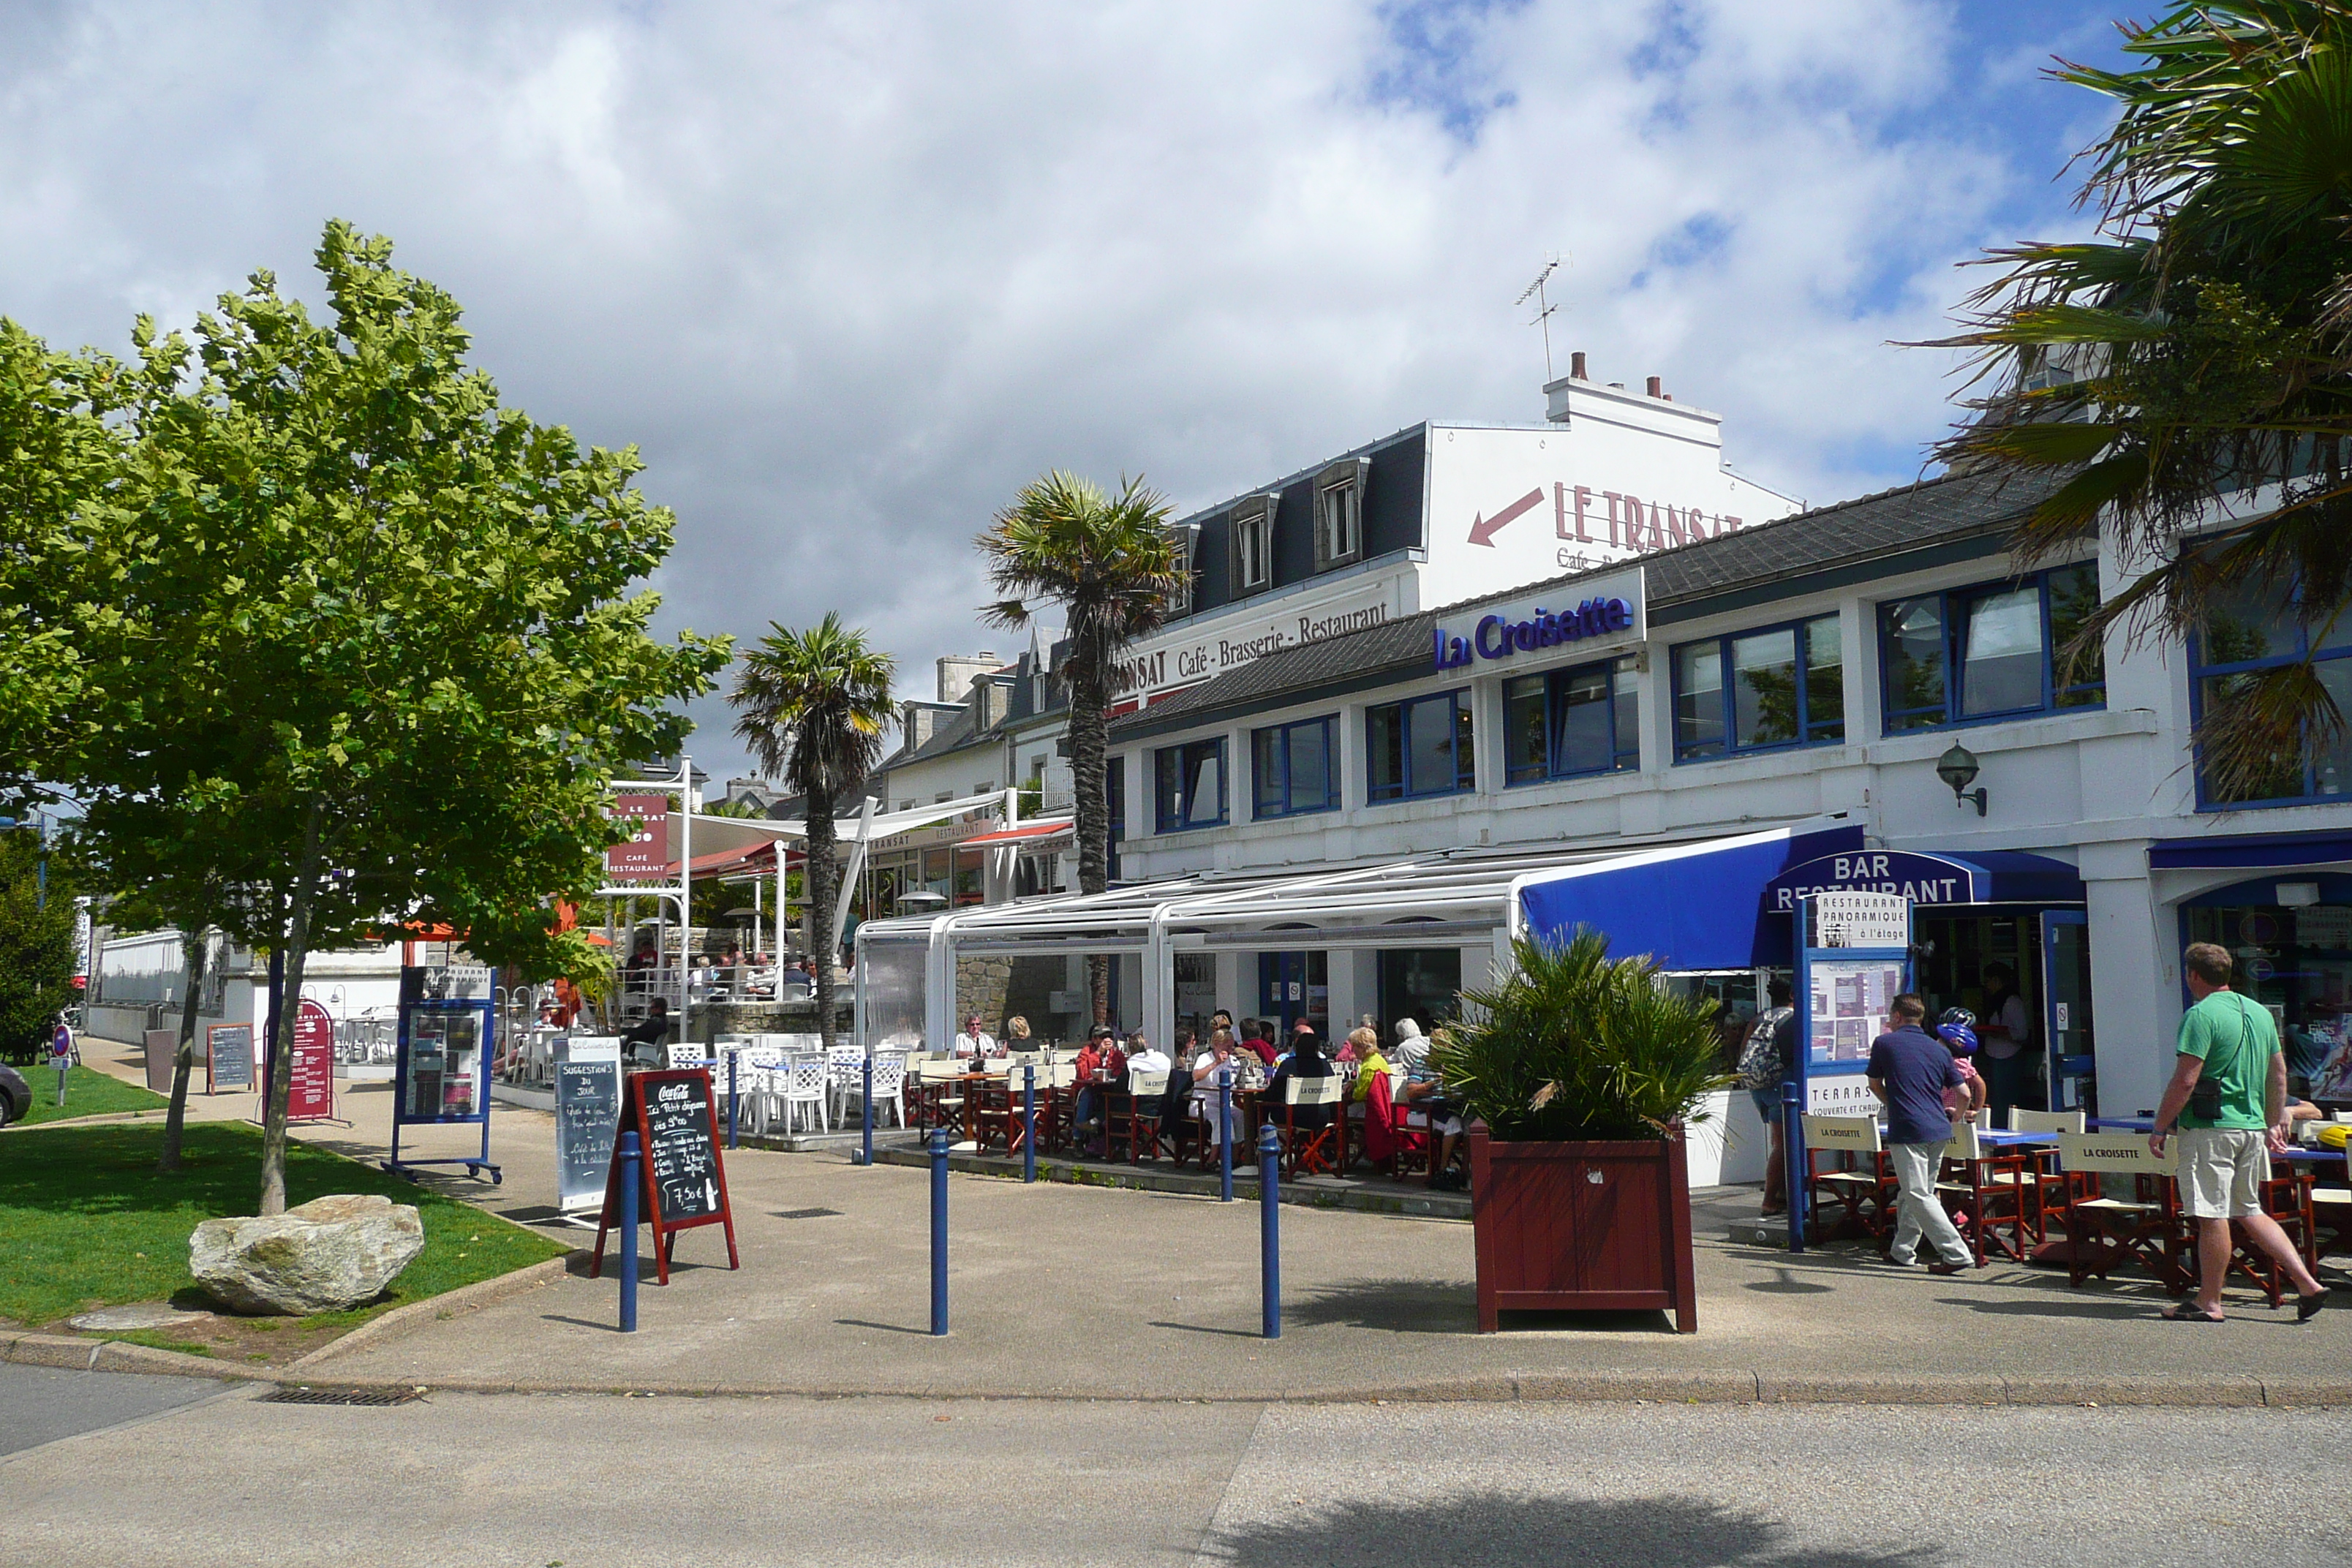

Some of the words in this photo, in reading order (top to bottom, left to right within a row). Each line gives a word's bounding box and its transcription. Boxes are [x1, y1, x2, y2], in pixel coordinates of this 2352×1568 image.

[1555, 481, 1593, 544] LE
[1602, 490, 1742, 554] TRANS
[1178, 645, 1207, 677] Café
[1218, 626, 1283, 667] Brasserie
[1298, 601, 1387, 643] Restaurant
[1433, 629, 1473, 670] La
[1475, 596, 1634, 660] Croisette
[937, 823, 979, 839] RESTAURANT
[870, 835, 910, 850] TRANSAT
[1835, 855, 1890, 879] BAR
[1823, 897, 1904, 908] RESTAURANT
[1823, 912, 1904, 922] PANORAMIQUE
[1861, 929, 1866, 938] à
[1870, 928, 1904, 940] l'étage
[562, 1064, 613, 1075] SUGGESTIONS
[576, 1086, 595, 1096] JOUR
[1812, 1085, 1871, 1101] TERRAS
[1813, 1105, 1847, 1117] COUVERTE
[1850, 1104, 1857, 1114] ET
[1830, 1129, 1861, 1137] CROISETTE
[2083, 1148, 2094, 1158] LA
[2095, 1149, 2139, 1158] CROISETTE
